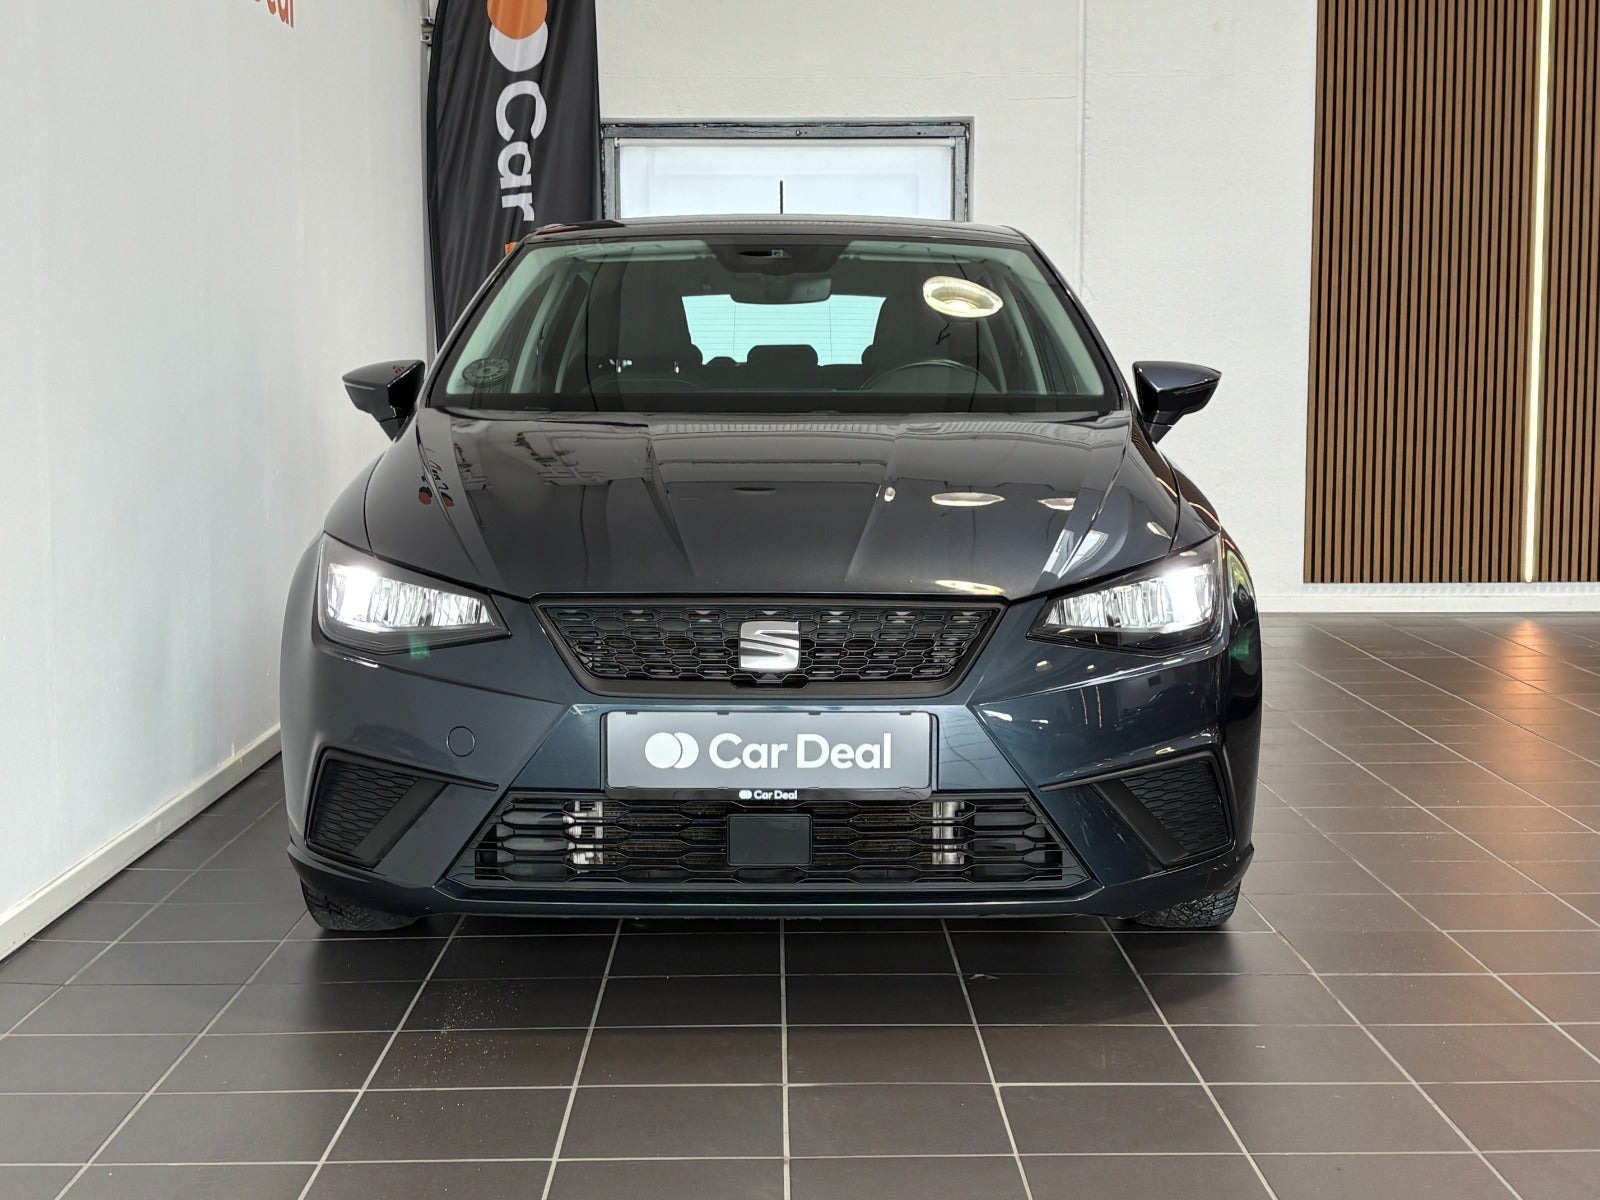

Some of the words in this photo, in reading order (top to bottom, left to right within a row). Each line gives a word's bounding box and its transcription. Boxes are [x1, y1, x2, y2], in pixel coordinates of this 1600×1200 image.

[496, 80, 547, 222] Car
[708, 732, 789, 769] Car
[796, 732, 892, 769] Deal
[753, 789, 774, 800] Car
[774, 789, 798, 800] Deal
